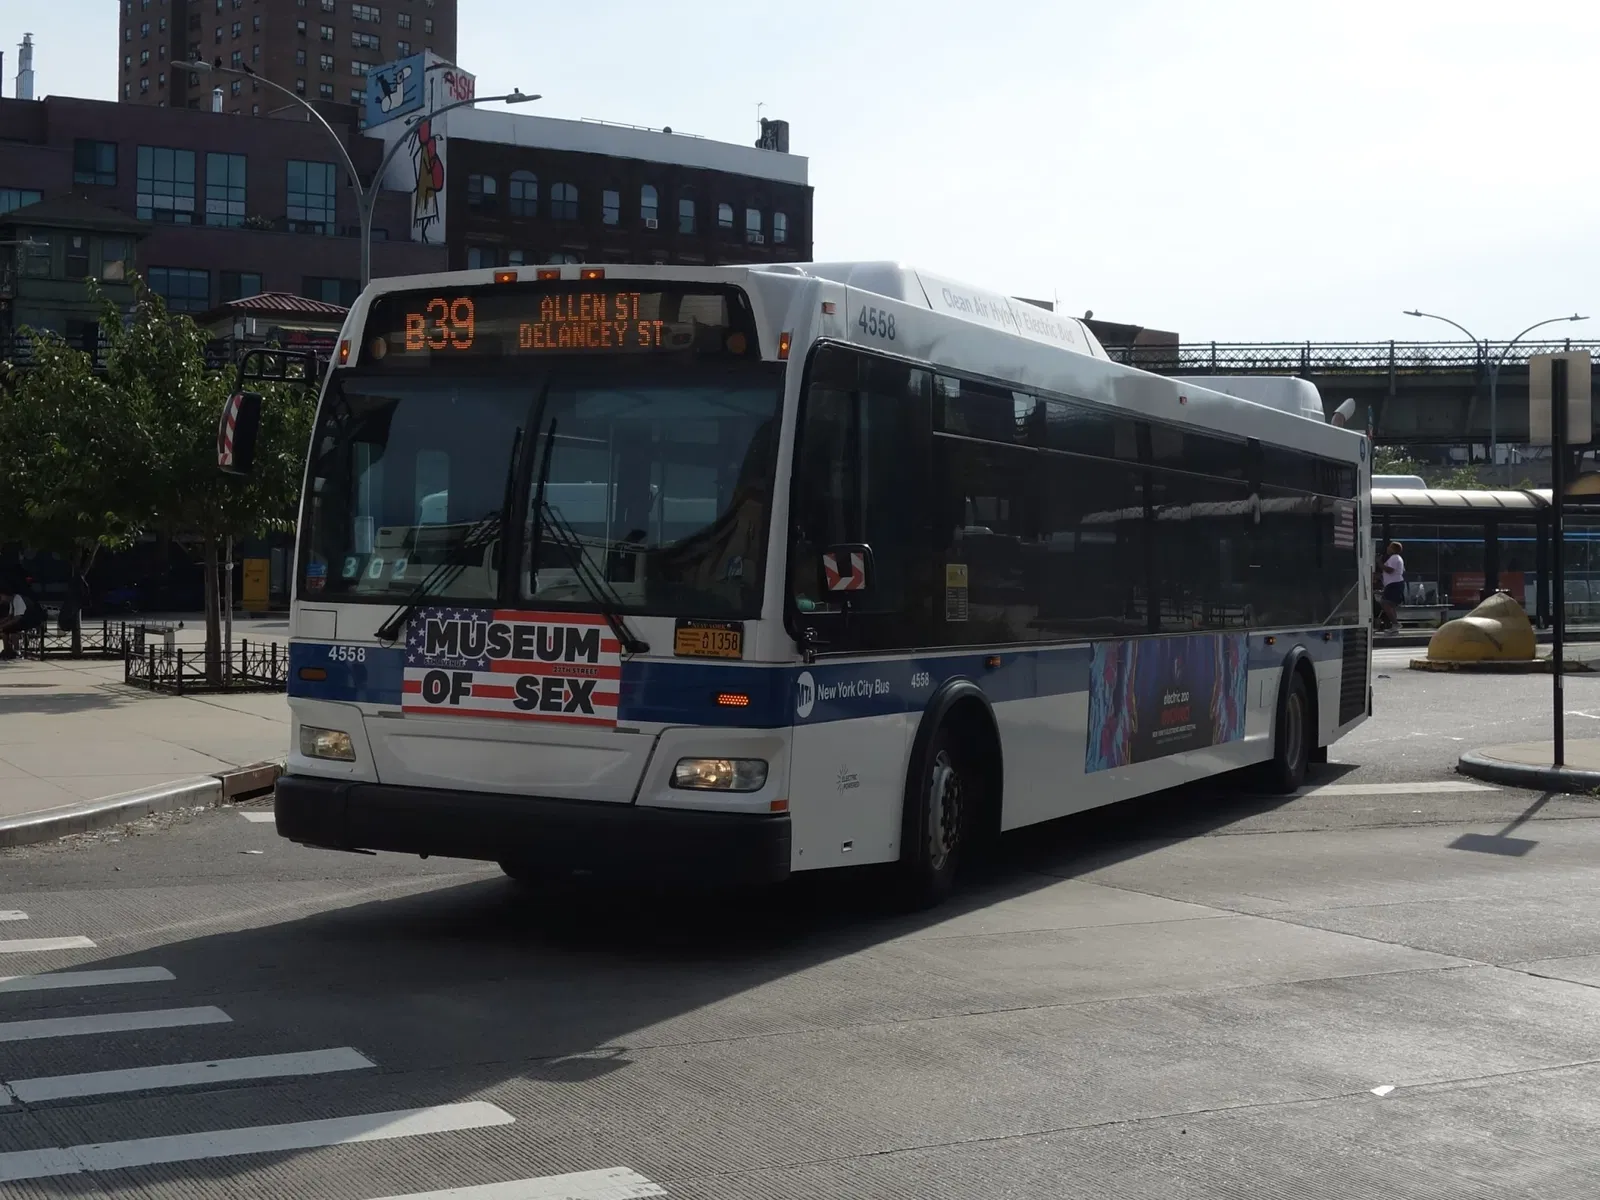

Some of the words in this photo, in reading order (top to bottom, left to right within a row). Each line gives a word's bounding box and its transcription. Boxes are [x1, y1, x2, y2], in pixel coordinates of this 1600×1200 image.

[541, 293, 606, 322] ALLEN
[615, 292, 640, 320] ST
[942, 287, 974, 313] Clean
[974, 295, 988, 318] Air
[989, 301, 1022, 328] Hybrd
[406, 297, 474, 350] B39
[519, 321, 628, 349] DELANCEY
[637, 320, 664, 346] ST
[858, 304, 896, 341] 4558
[328, 645, 366, 663] 4558
[423, 618, 601, 664] MUSEUM
[572, 667, 598, 675] STREET
[911, 672, 930, 689] 4558
[422, 669, 473, 705] OF
[512, 676, 599, 715] SEX
[817, 684, 837, 700] New
[837, 681, 856, 698] York
[857, 680, 873, 698] City
[875, 679, 890, 694] Bus
